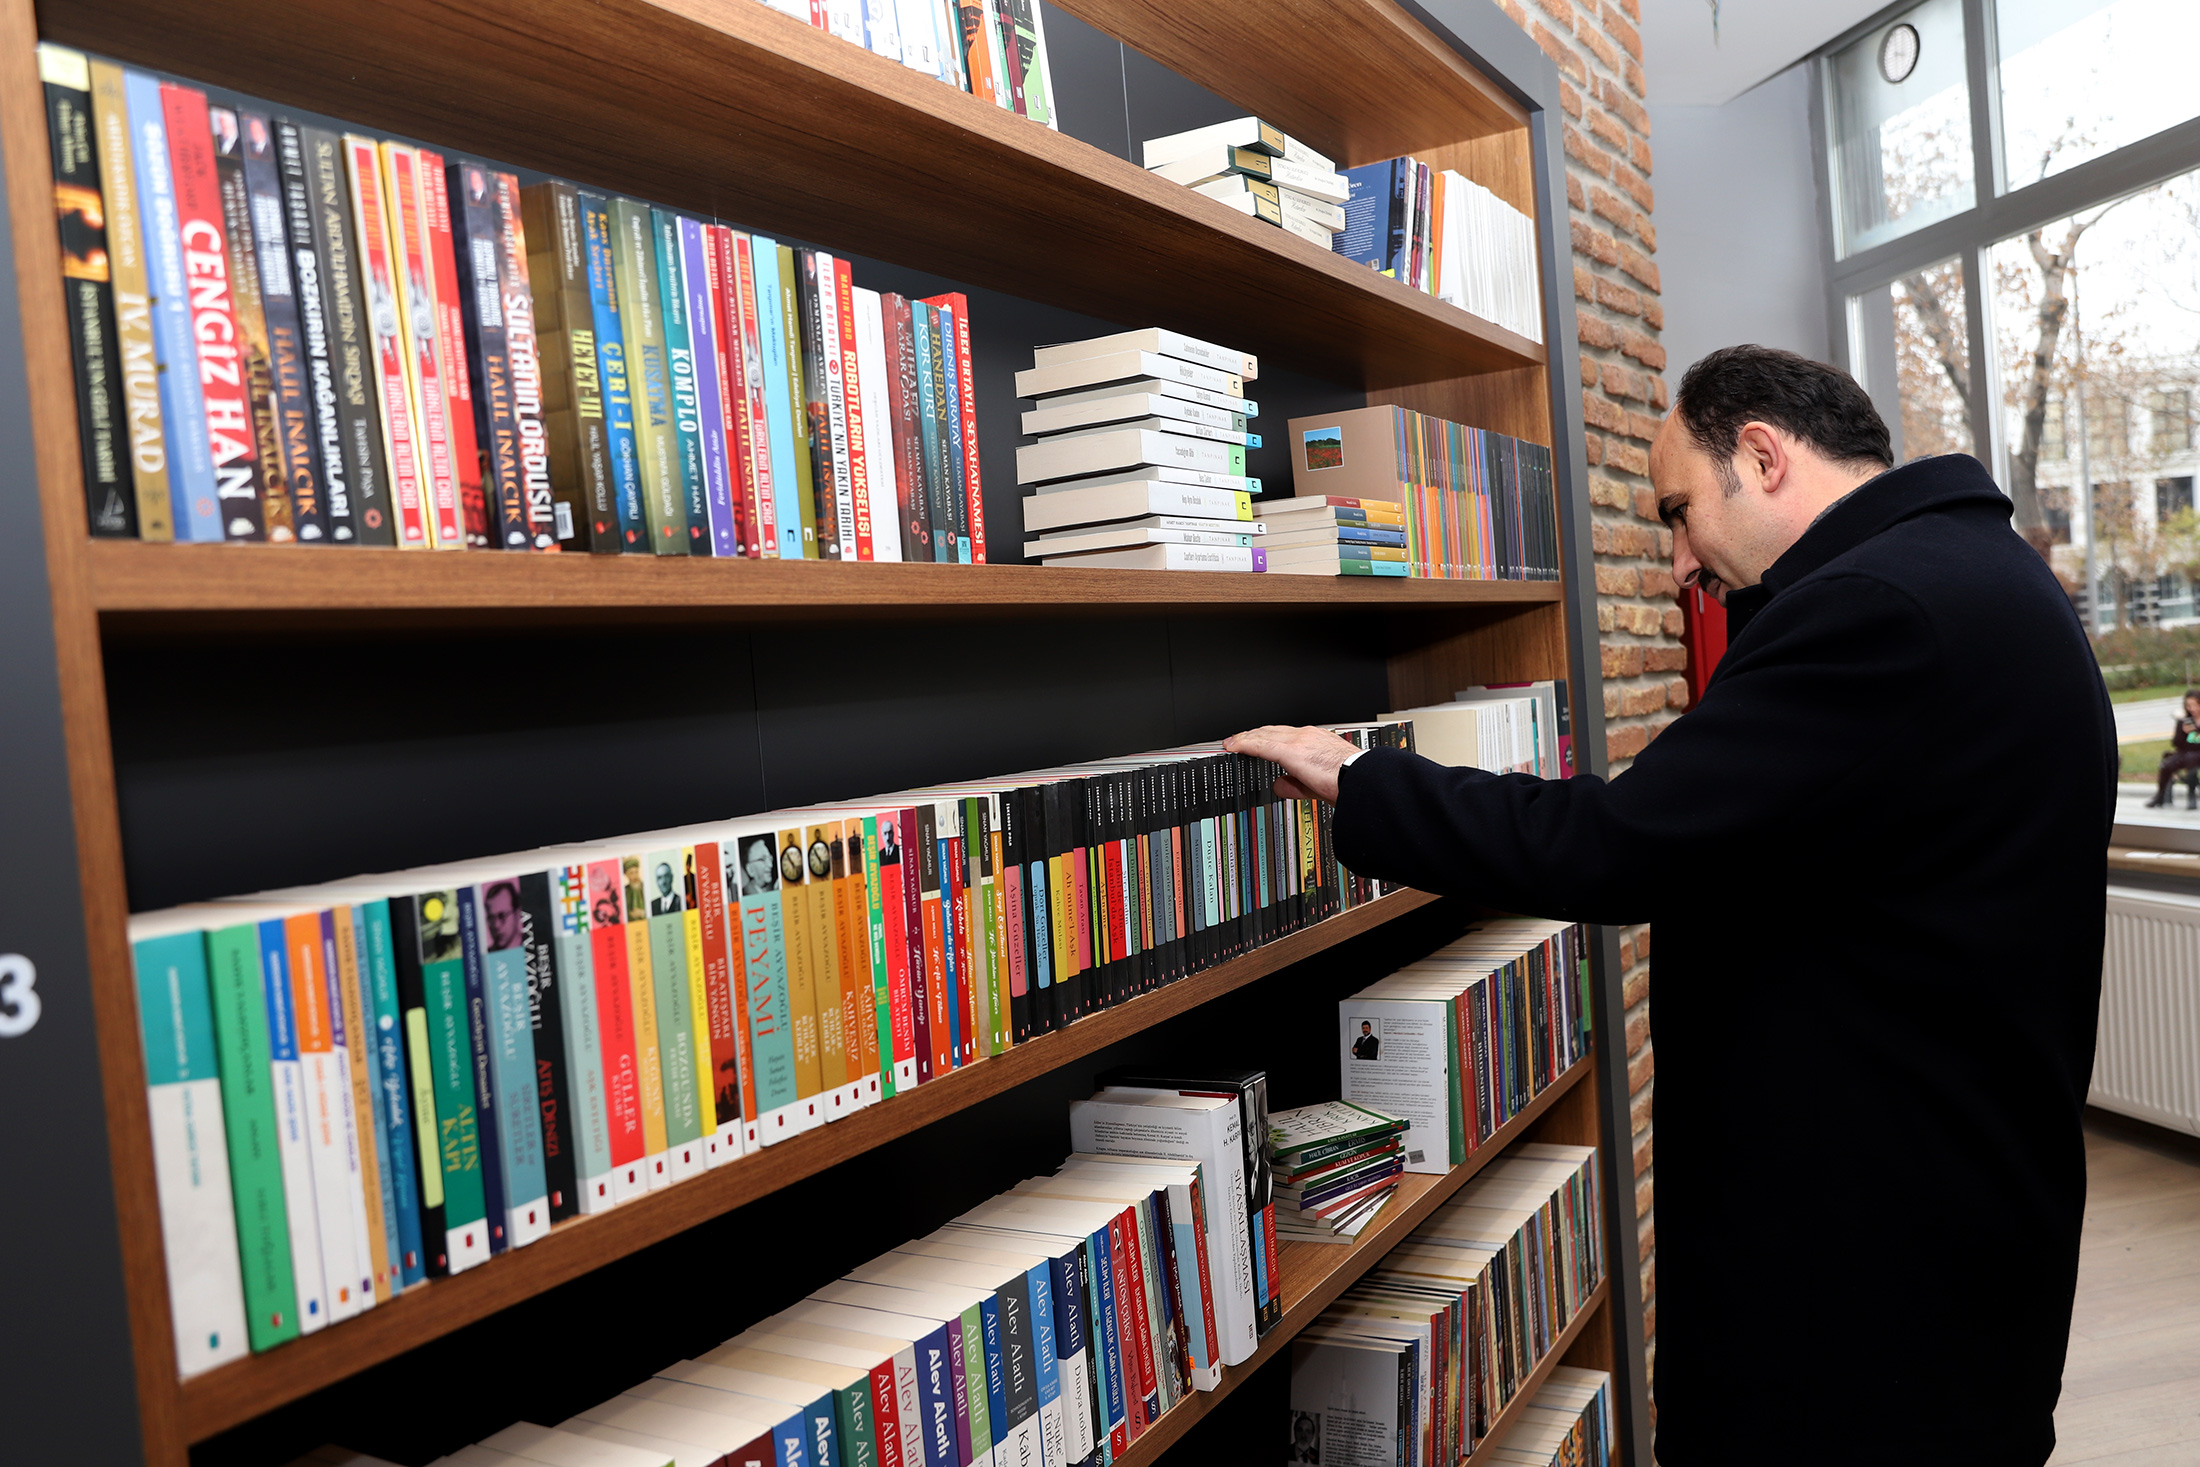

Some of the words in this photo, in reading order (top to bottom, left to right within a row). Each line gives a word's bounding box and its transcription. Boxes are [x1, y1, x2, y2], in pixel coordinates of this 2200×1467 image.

[315, 141, 339, 206] SULTAN
[118, 292, 150, 332] IV.
[182, 220, 242, 386] CENGİZ
[296, 249, 328, 357] BOZKIRIN
[840, 274, 852, 312] MARTIN
[503, 294, 542, 413] SULTANIN
[844, 315, 853, 341] FORD
[897, 322, 908, 371] KARAR
[918, 323, 931, 367] KOR
[944, 322, 957, 377] DİRENİŞ
[671, 348, 698, 433] KOMPLO
[843, 350, 867, 452] ROBOTLARIN
[922, 370, 937, 423] KURT
[931, 334, 947, 421] HANEDAN
[961, 359, 975, 413] ORTAYLI
[123, 338, 165, 474] MURAD
[947, 383, 962, 449] KARATAY
[204, 396, 257, 500] HAN
[311, 359, 350, 517] KAĞANLIKLARI
[686, 438, 699, 482] AHMET
[941, 439, 949, 475] SELMAN
[517, 420, 555, 523] ORDUSU
[835, 461, 851, 497] YAKIN
[852, 456, 871, 538] YÜKSELİŞİ
[966, 420, 985, 544] SEYAHATNAMESİ
[691, 486, 703, 514] HAN
[1055, 889, 1063, 918] Kahve
[1065, 872, 1072, 889] Ah
[1207, 875, 1216, 905] Kalan
[1012, 923, 1023, 977] Güzeller
[1040, 921, 1049, 961] Güzeller
[0, 953, 42, 1039] 3
[746, 904, 781, 1039] PEYAMİ
[846, 990, 860, 1063] KAHVENİZ
[863, 984, 878, 1055] KAHVENİZ
[616, 1053, 637, 1133] GÜLLER
[441, 1117, 461, 1173] KAPI
[1138, 1219, 1148, 1249] Ortak
[1063, 1261, 1076, 1297] Alev
[1141, 1252, 1152, 1284] Payda
[1006, 1296, 1021, 1336] Alev
[1035, 1279, 1051, 1318] Alev
[965, 1323, 980, 1363] Alev
[1039, 1325, 1056, 1375] Alatlı
[1067, 1303, 1082, 1350] Alatlı
[878, 1374, 893, 1413] Alev
[898, 1366, 915, 1412] Alev
[928, 1349, 943, 1394] Alev
[1009, 1342, 1026, 1394] Alatlı
[1073, 1364, 1088, 1408] Dünya
[851, 1391, 866, 1432] Alev
[969, 1372, 986, 1424] Alatlı
[815, 1416, 832, 1467] Alev
[933, 1402, 951, 1459] Alatlı
